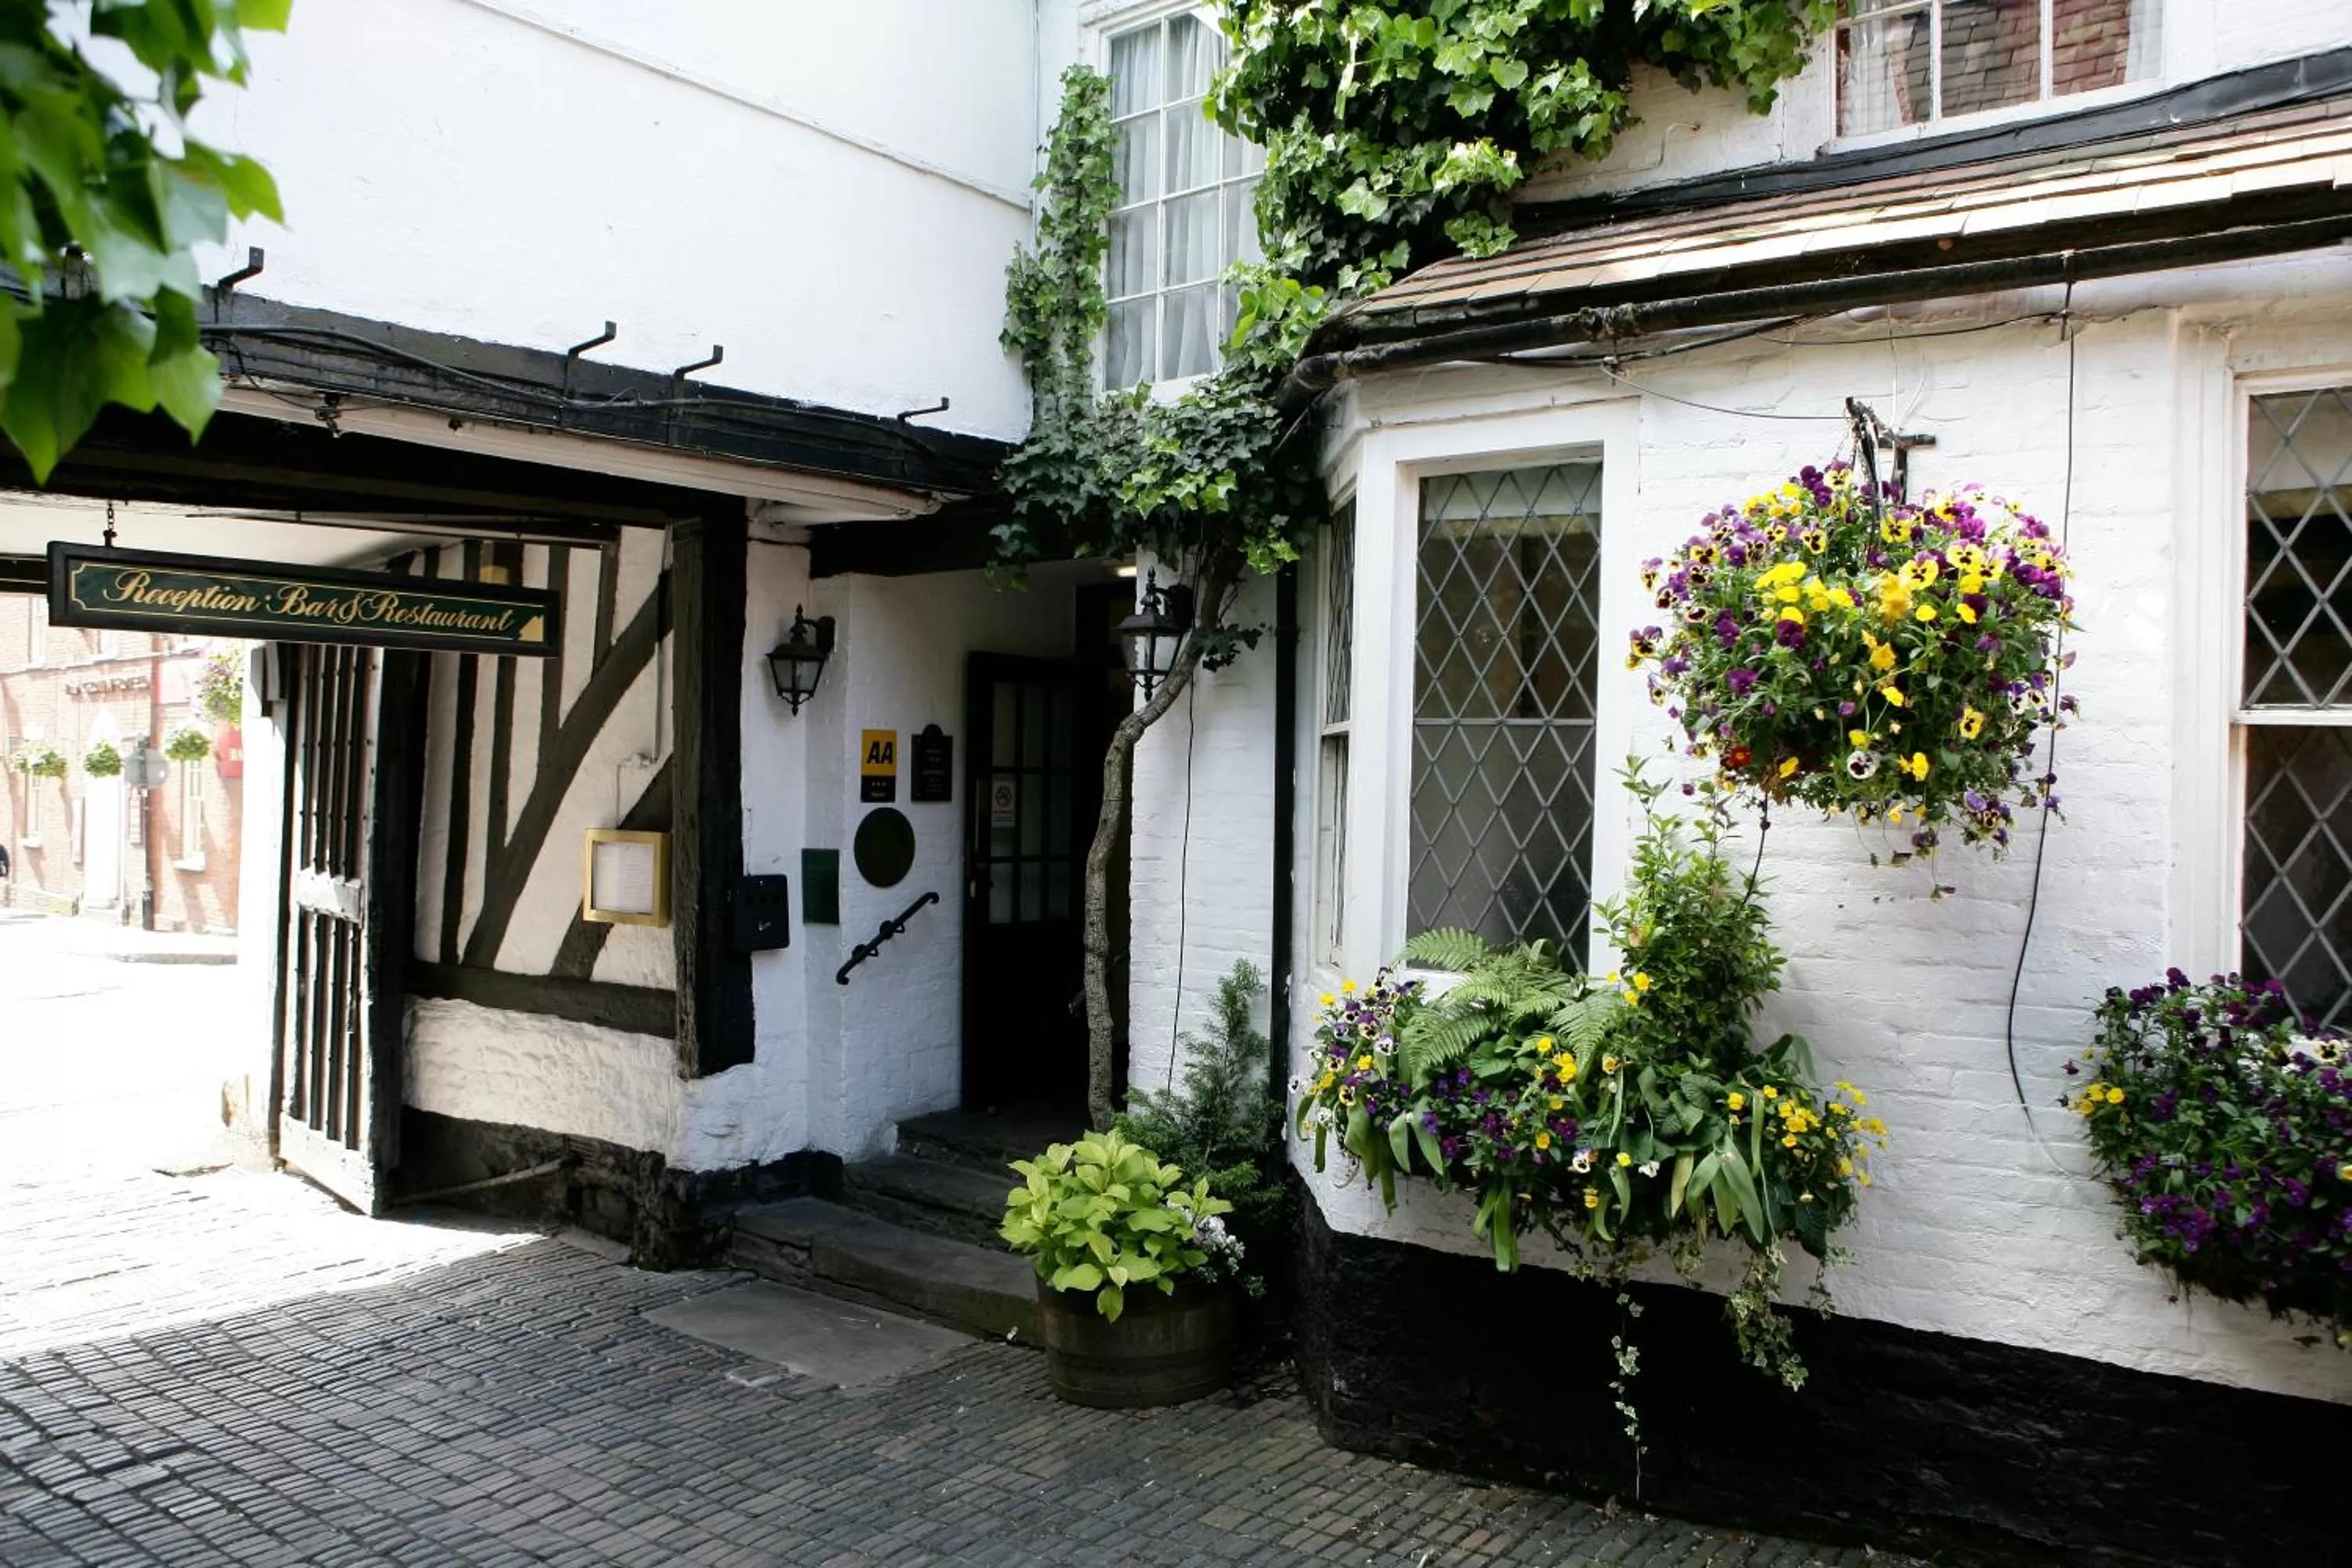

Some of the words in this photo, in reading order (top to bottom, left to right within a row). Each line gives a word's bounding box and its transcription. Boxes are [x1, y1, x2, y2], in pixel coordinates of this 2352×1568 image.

[103, 570, 262, 612] Reception
[358, 592, 514, 631] Restaurant
[866, 740, 893, 764] AA
